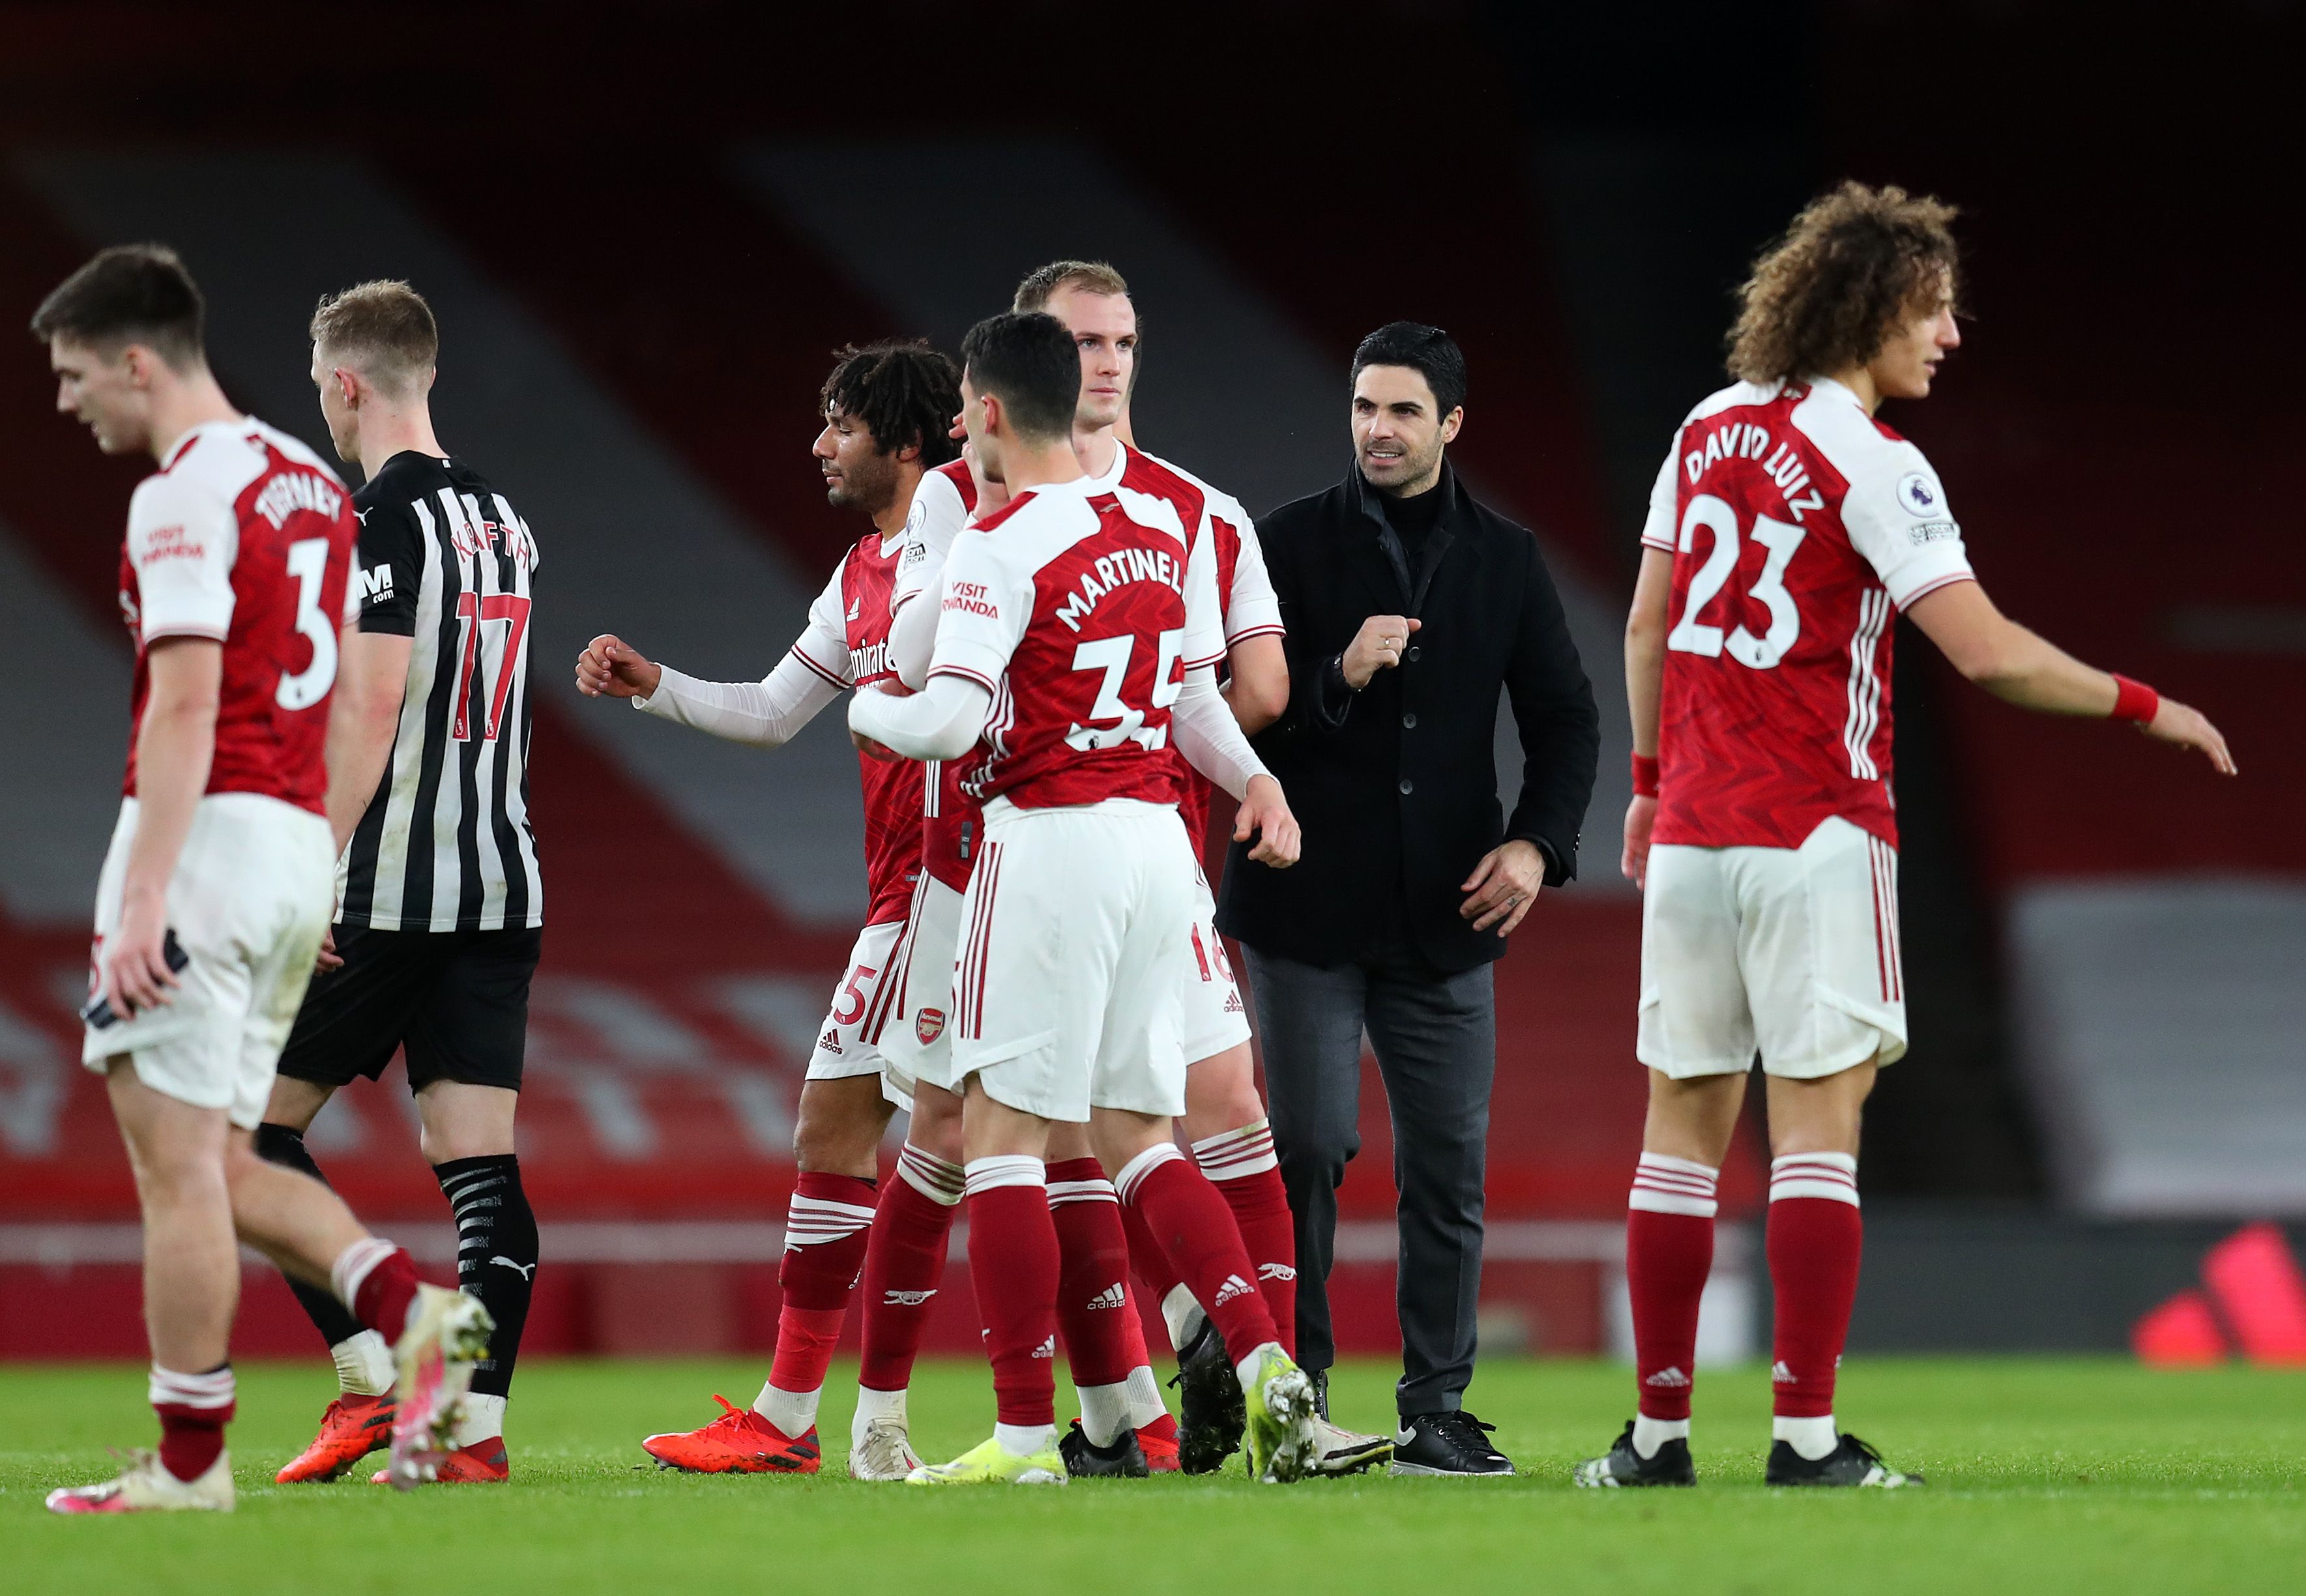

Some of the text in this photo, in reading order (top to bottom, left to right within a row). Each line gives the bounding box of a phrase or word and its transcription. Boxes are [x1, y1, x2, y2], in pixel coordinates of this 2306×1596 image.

[1685, 422, 1824, 521] DAVID LUIZ
[275, 537, 340, 711] 3
[373, 588, 394, 604] com
[952, 582, 988, 599] VISIT
[1055, 548, 1185, 633] MARTINEL
[1667, 493, 1807, 670] 23
[452, 591, 532, 744] 17
[1063, 627, 1185, 752] 35
[833, 965, 878, 1025] 5
[819, 1040, 843, 1054] adidas
[1215, 1286, 1255, 1307] adidas
